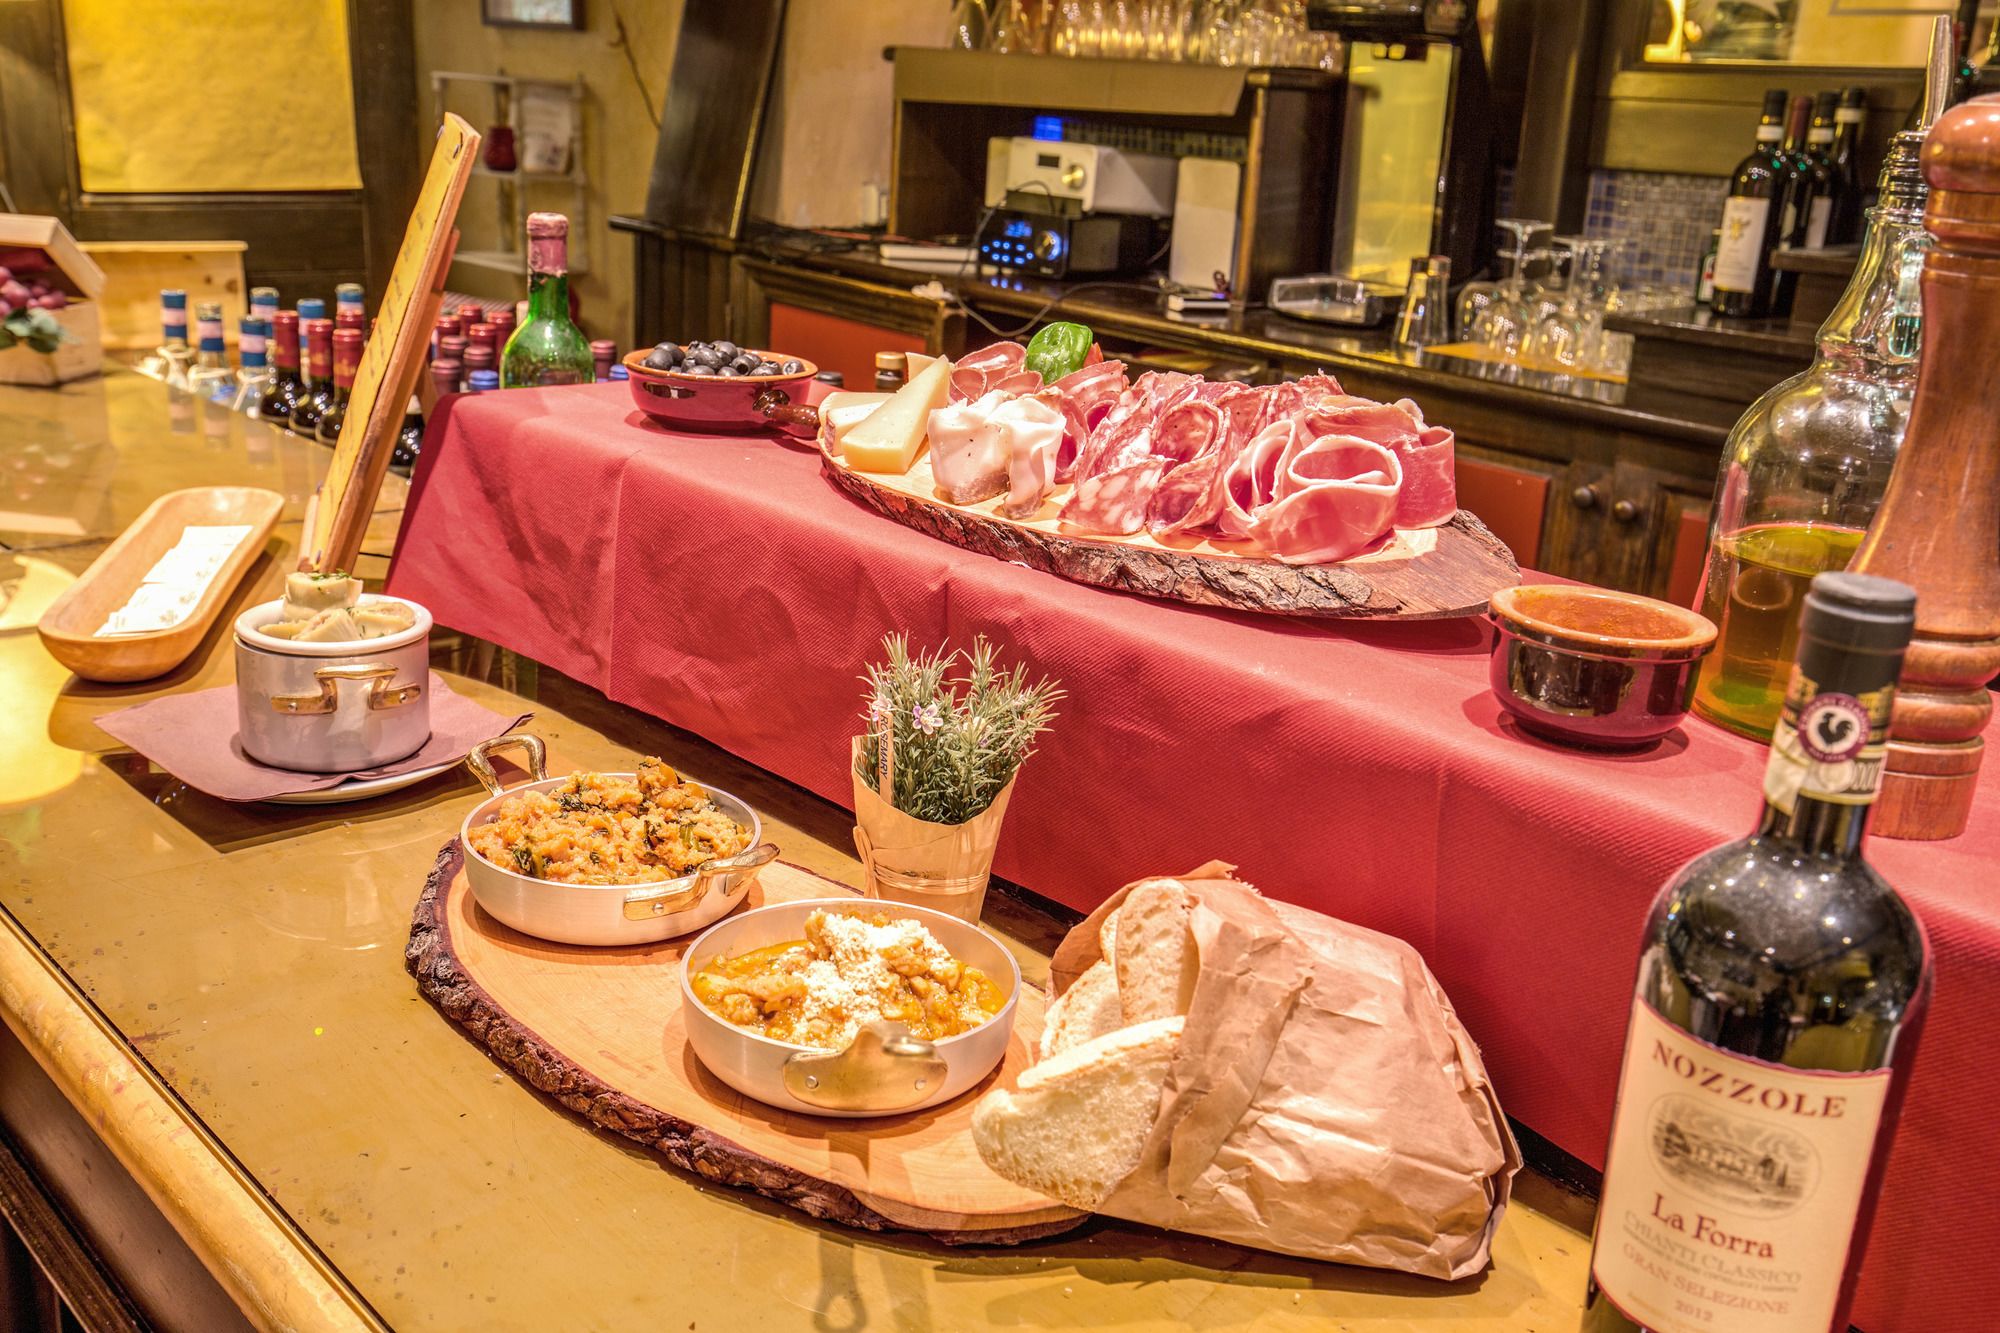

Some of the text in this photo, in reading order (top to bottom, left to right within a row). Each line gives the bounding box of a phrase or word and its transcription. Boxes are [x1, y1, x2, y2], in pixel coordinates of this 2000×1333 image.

[879, 714, 889, 779] ROSEMARY
[1651, 1039, 1847, 1119] NOZZOLE
[1624, 1209, 1697, 1263] CHIANTI
[1701, 1252, 1802, 1285] CLASSICO
[1651, 1192, 1685, 1233] La
[1692, 1213, 1775, 1260] Forra
[1623, 1242, 1671, 1284] GRAN
[1673, 1274, 1791, 1315] SELEZIONE
[1675, 1299, 1714, 1322] 2012
